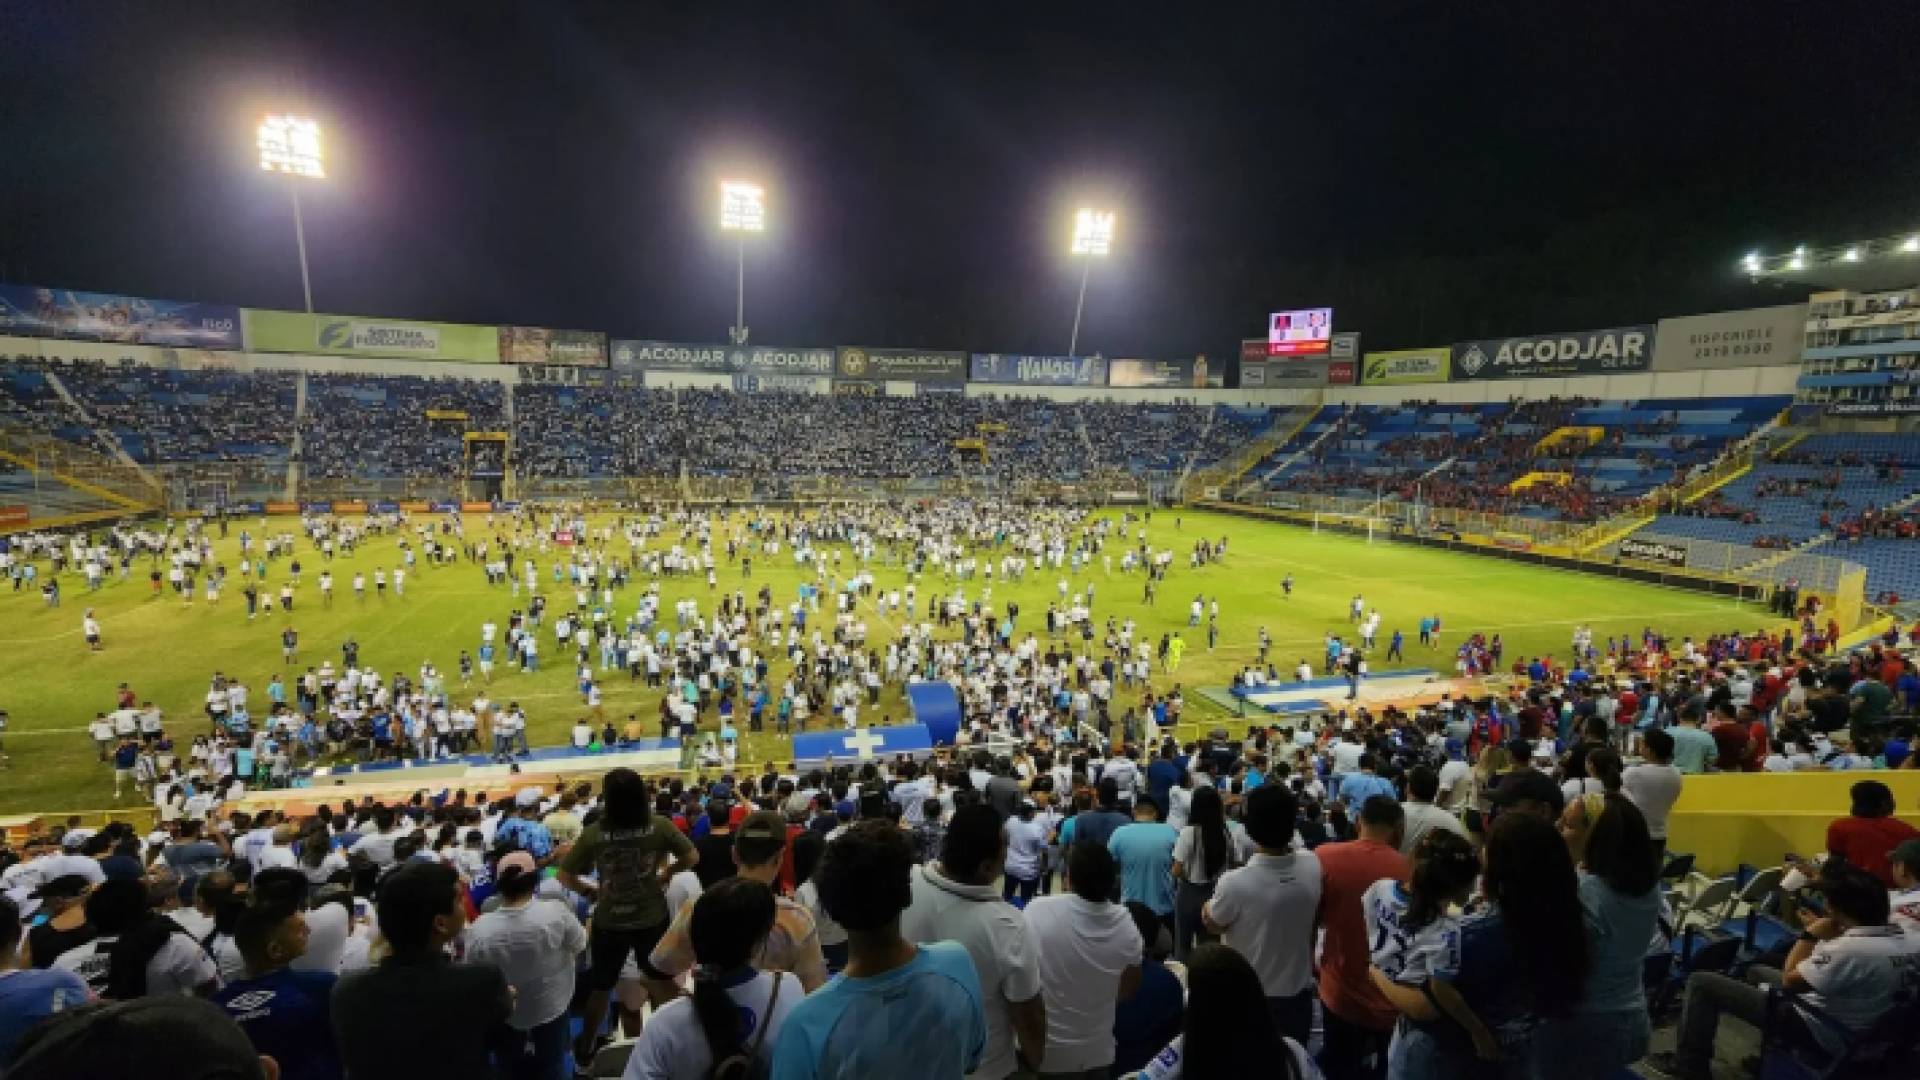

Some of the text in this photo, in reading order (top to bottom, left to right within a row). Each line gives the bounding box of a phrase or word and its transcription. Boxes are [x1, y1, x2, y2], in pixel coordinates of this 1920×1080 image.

[639, 348, 725, 363] ACODJAR
[1492, 335, 1646, 365] ACODJAR
[752, 351, 830, 370] ACODJAR
